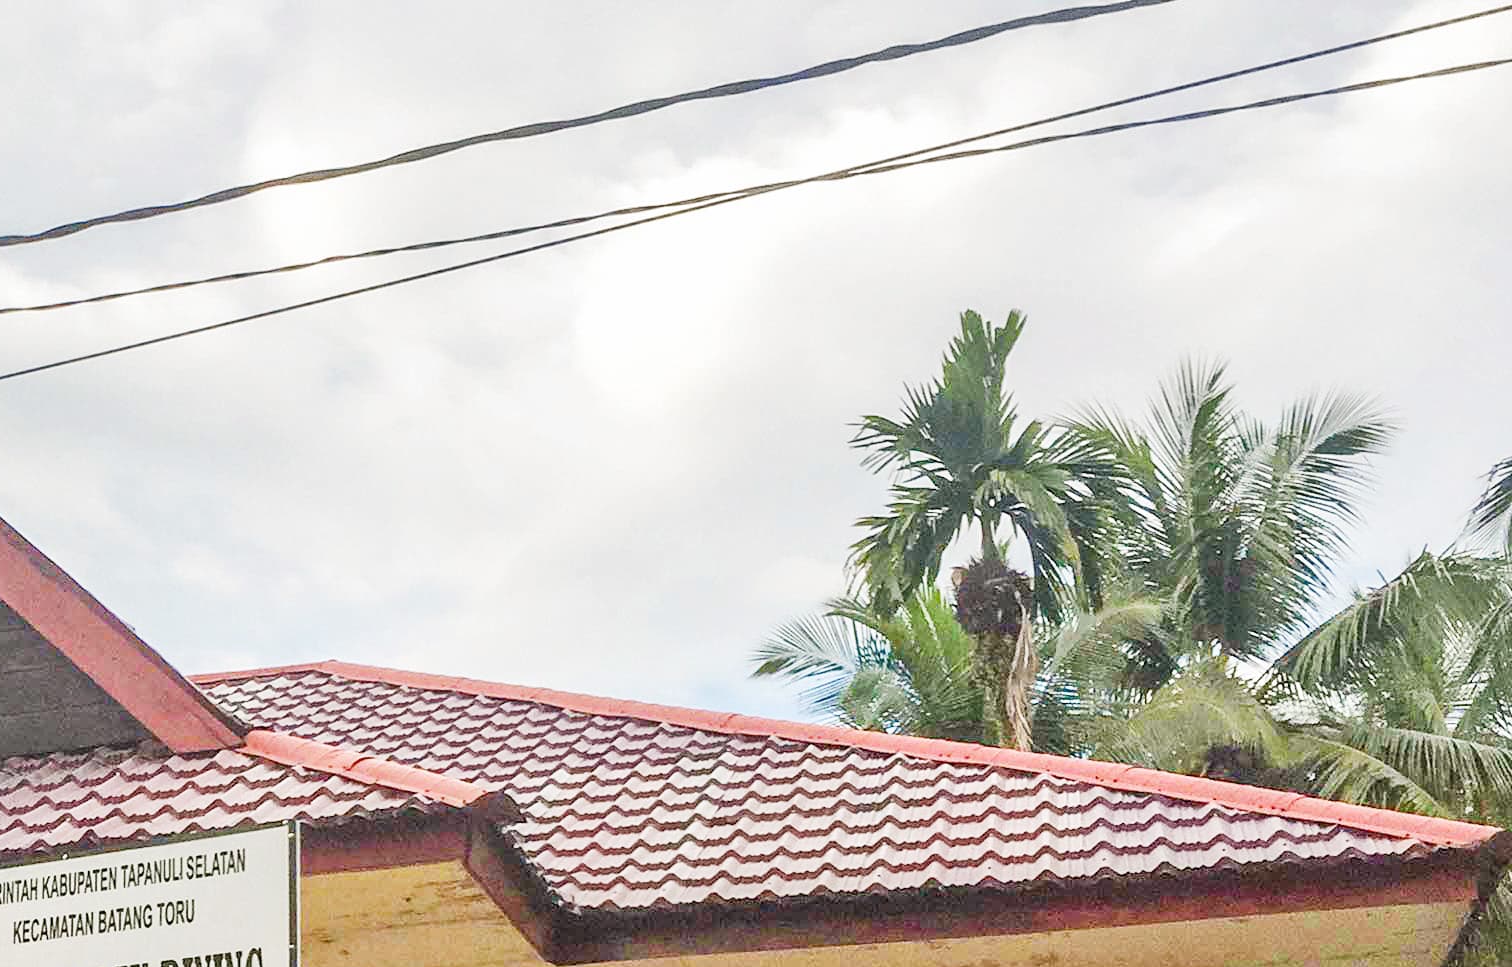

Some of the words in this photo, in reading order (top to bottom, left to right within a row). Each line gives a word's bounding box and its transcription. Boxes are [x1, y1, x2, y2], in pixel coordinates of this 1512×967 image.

[42, 867, 117, 899] KABUPATEN
[121, 857, 183, 888] TAPANULI
[187, 849, 245, 880] SELATAN
[14, 912, 93, 944] KECAMATAN
[99, 904, 152, 933] BATANG
[157, 899, 194, 926] TORU
